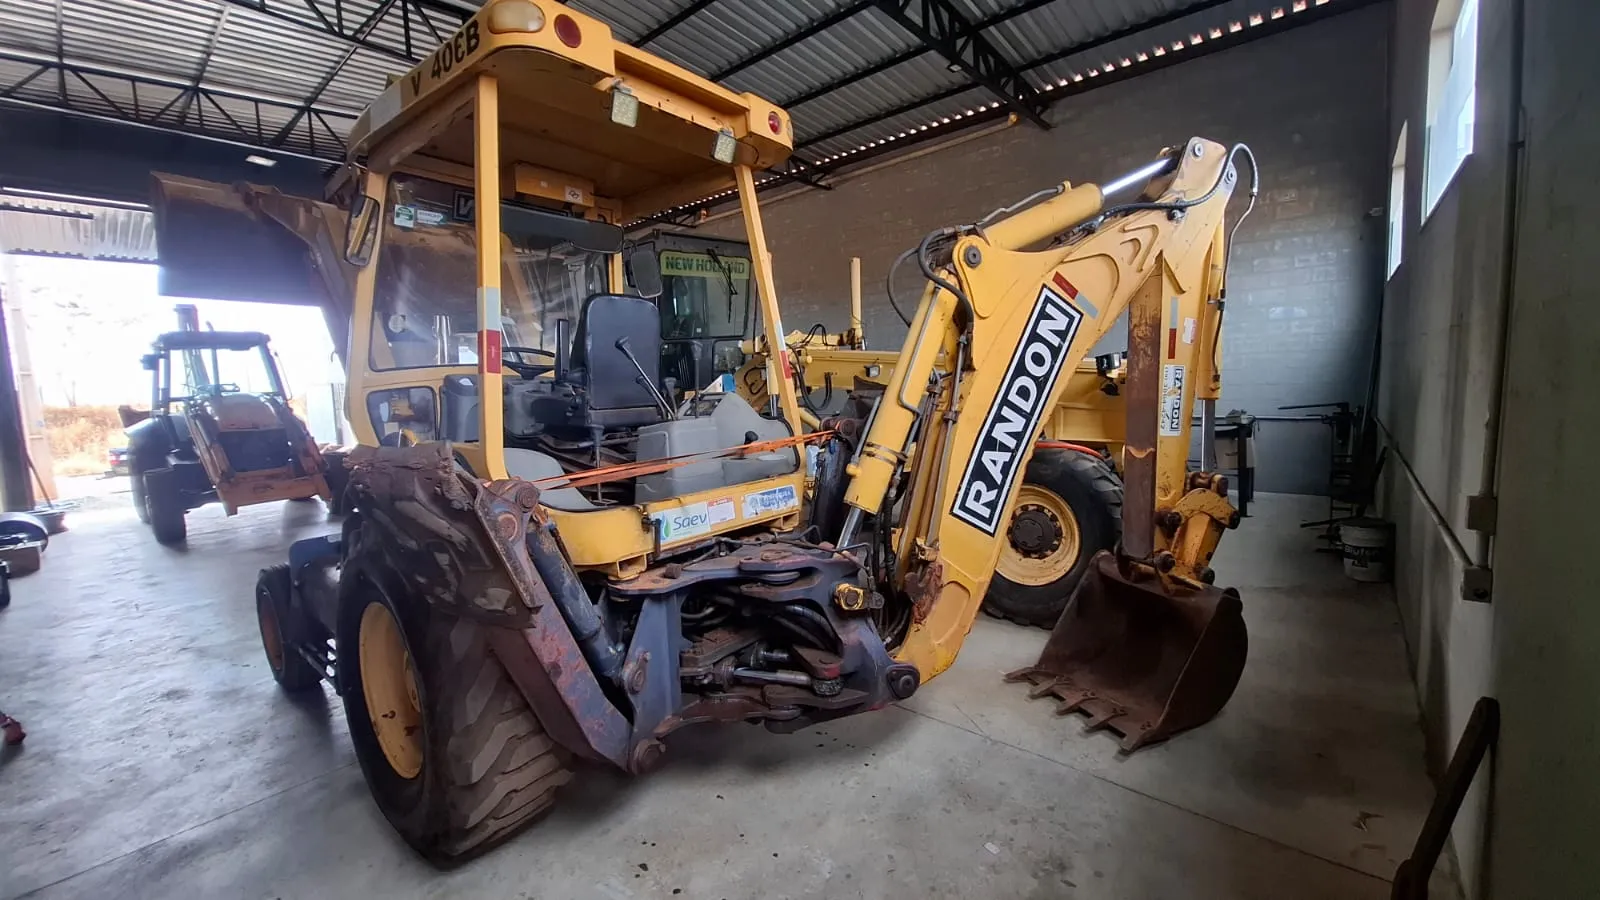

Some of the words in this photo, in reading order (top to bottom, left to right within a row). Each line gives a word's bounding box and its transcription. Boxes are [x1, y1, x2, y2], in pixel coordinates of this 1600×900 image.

[665, 256, 693, 271] NEW
[696, 259, 745, 274] HOLND
[965, 302, 1071, 519] RANDON
[672, 513, 707, 531] Saev
